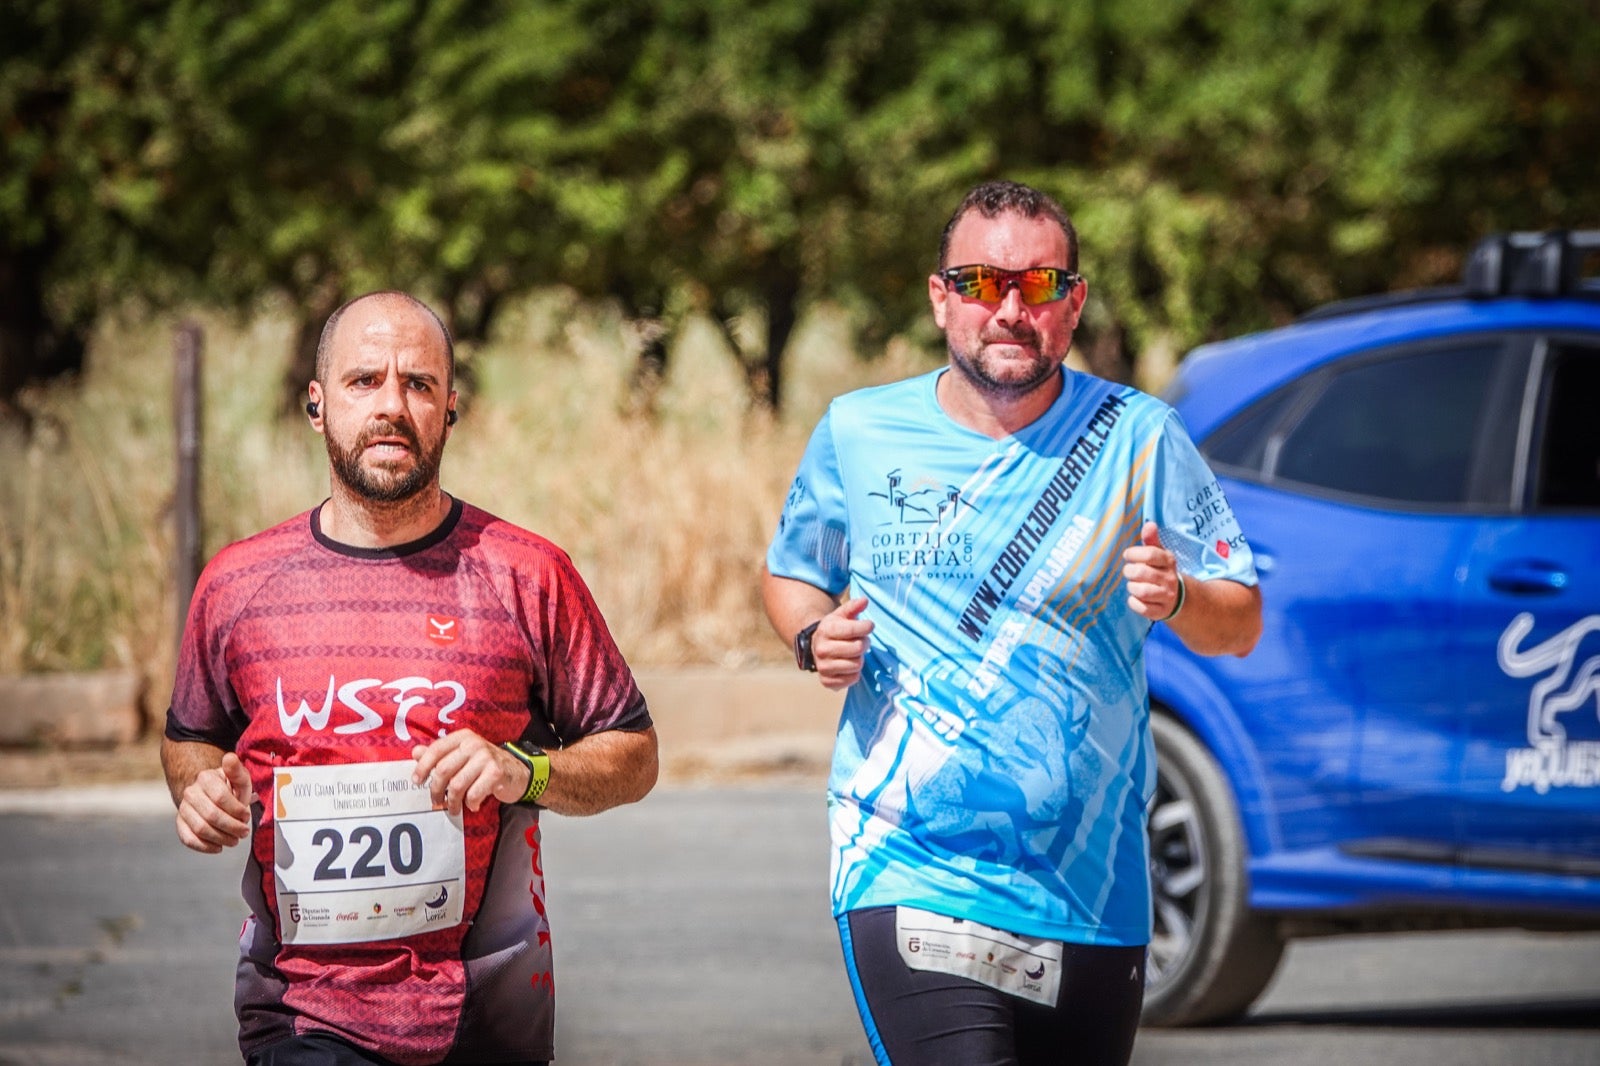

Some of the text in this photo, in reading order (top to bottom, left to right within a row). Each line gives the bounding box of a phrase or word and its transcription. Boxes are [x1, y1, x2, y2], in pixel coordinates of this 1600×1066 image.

[871, 532, 961, 549] CORTIJO
[957, 393, 1128, 644] WWW.CORTIJOPUERTA.COM
[927, 572, 975, 580] DETALLE
[1014, 513, 1097, 617] ALPUJARRA
[276, 674, 467, 741] WSF?
[293, 783, 312, 798] XXXV
[382, 778, 409, 792] FONDO
[312, 823, 423, 881] 220
